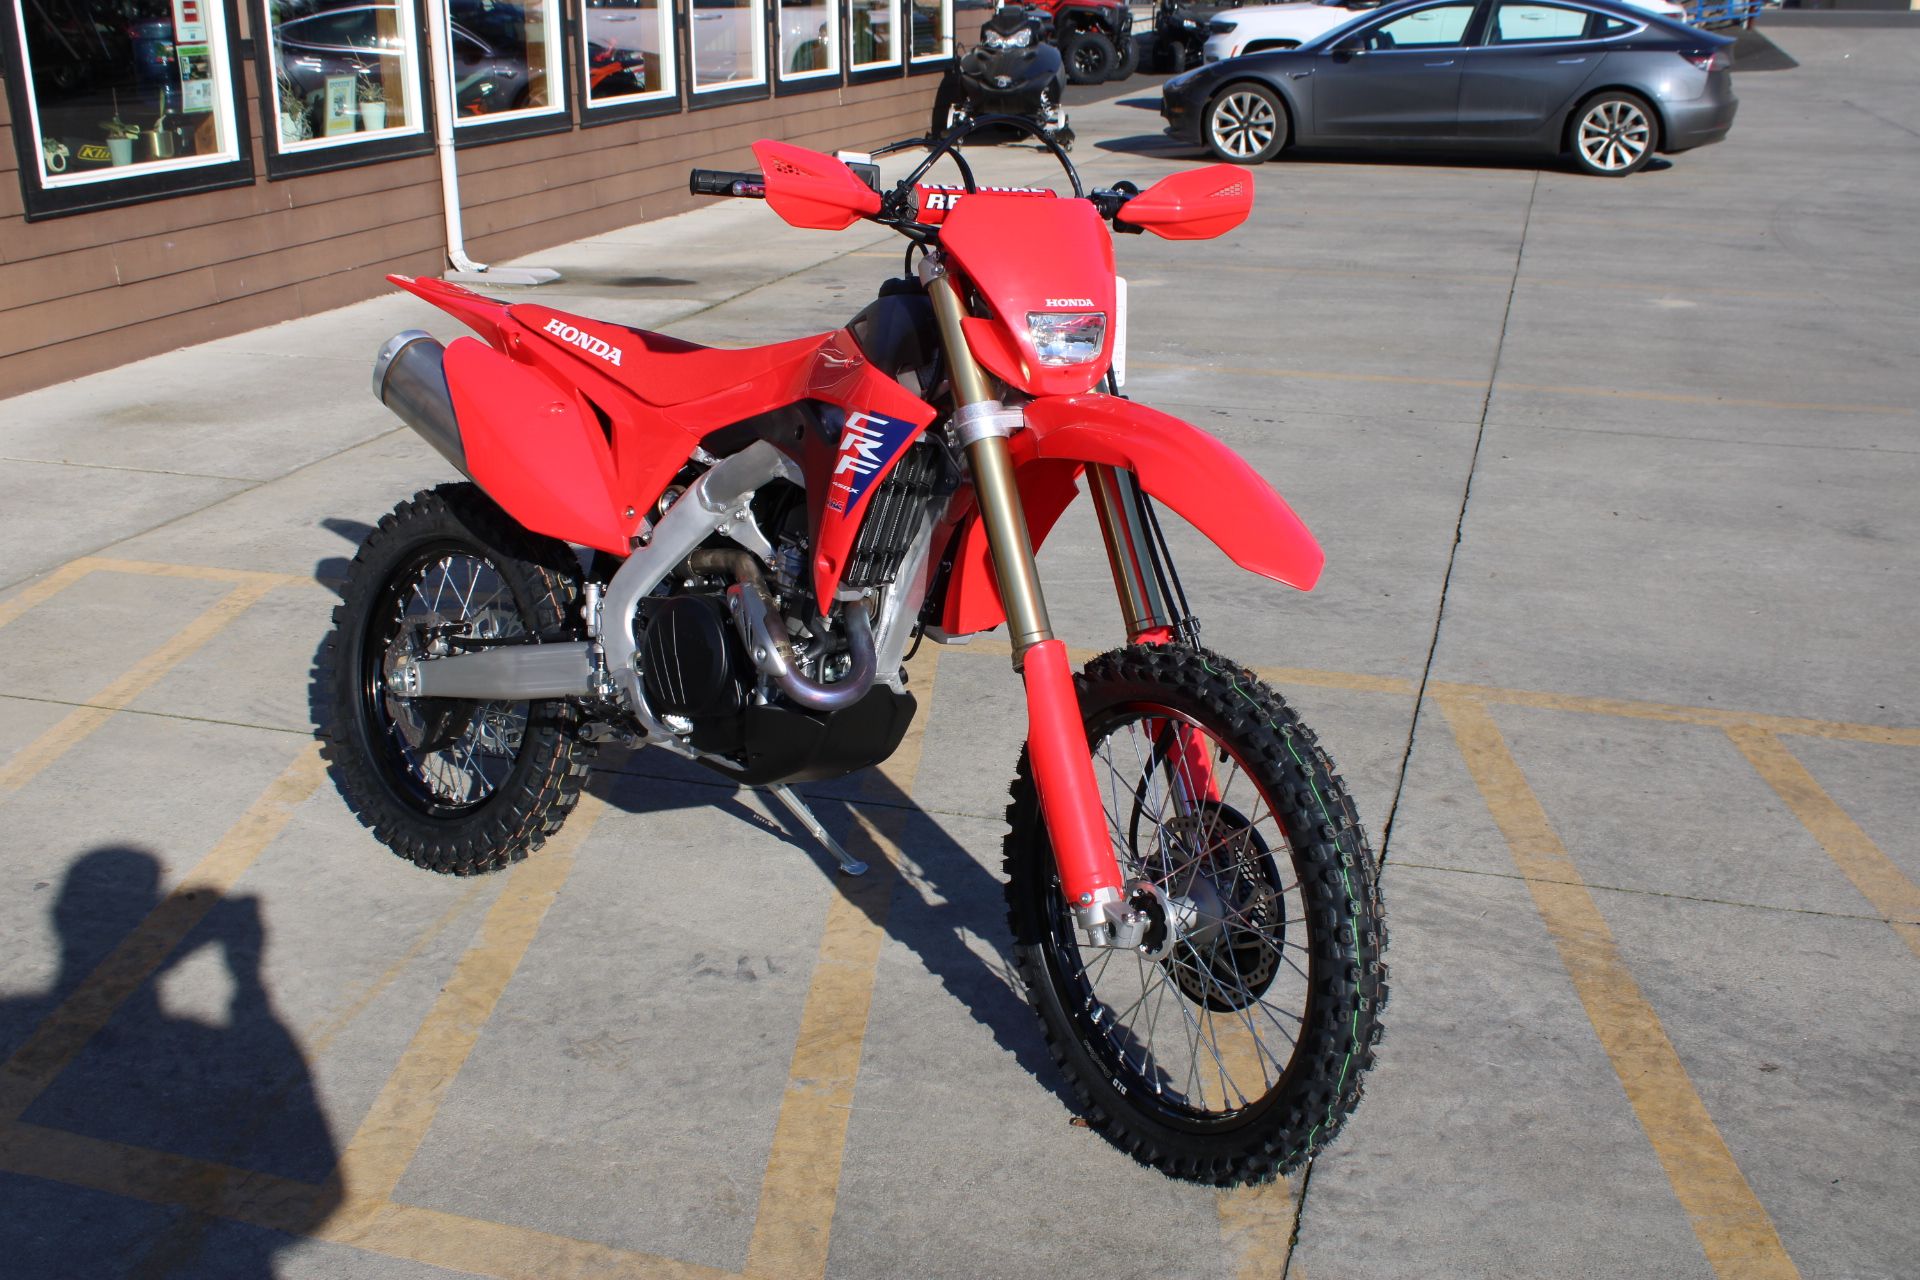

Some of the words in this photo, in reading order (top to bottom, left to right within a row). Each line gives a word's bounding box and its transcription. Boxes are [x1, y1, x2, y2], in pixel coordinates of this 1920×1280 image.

[1045, 298, 1095, 307] HONDA
[543, 318, 623, 367] HONDA
[833, 411, 890, 475] CRF
